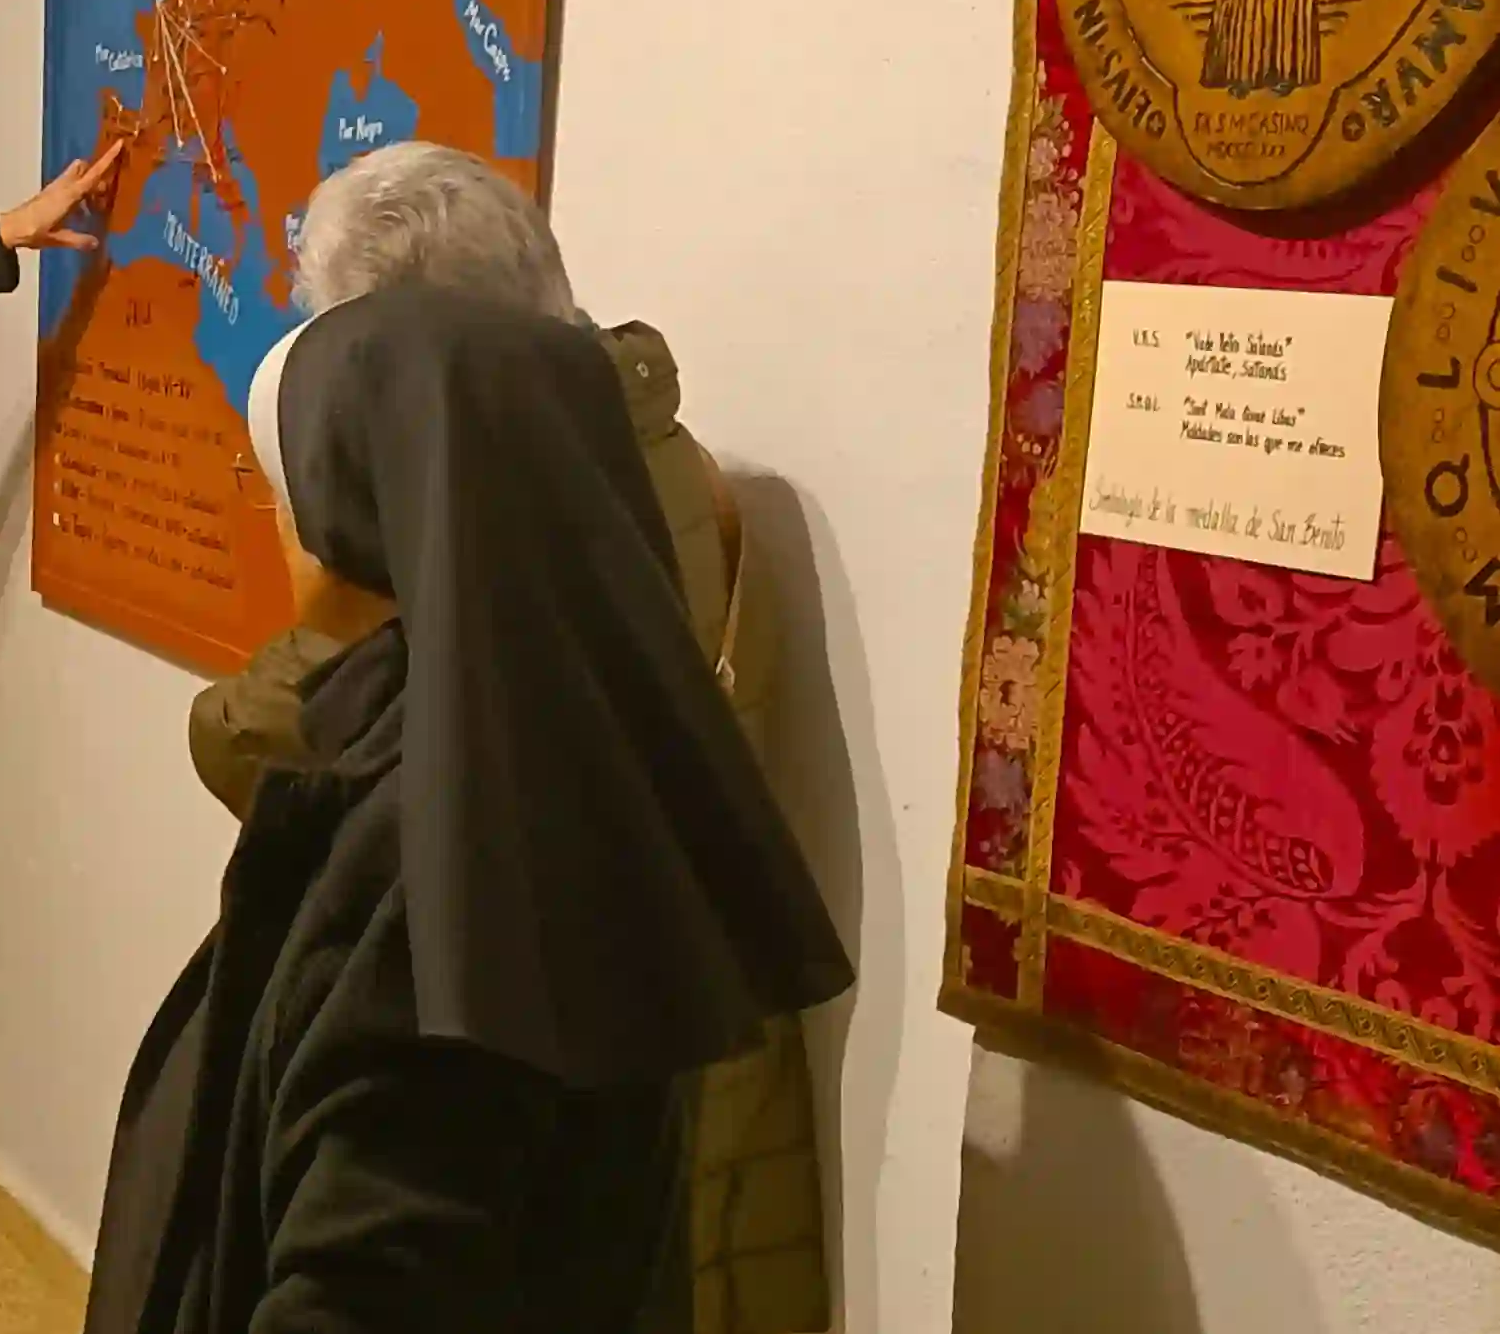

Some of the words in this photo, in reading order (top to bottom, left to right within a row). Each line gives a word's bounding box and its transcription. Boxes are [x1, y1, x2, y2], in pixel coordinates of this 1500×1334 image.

[1245, 505, 1262, 539] de
[1267, 510, 1296, 544] San
[1298, 513, 1345, 551] Benito
